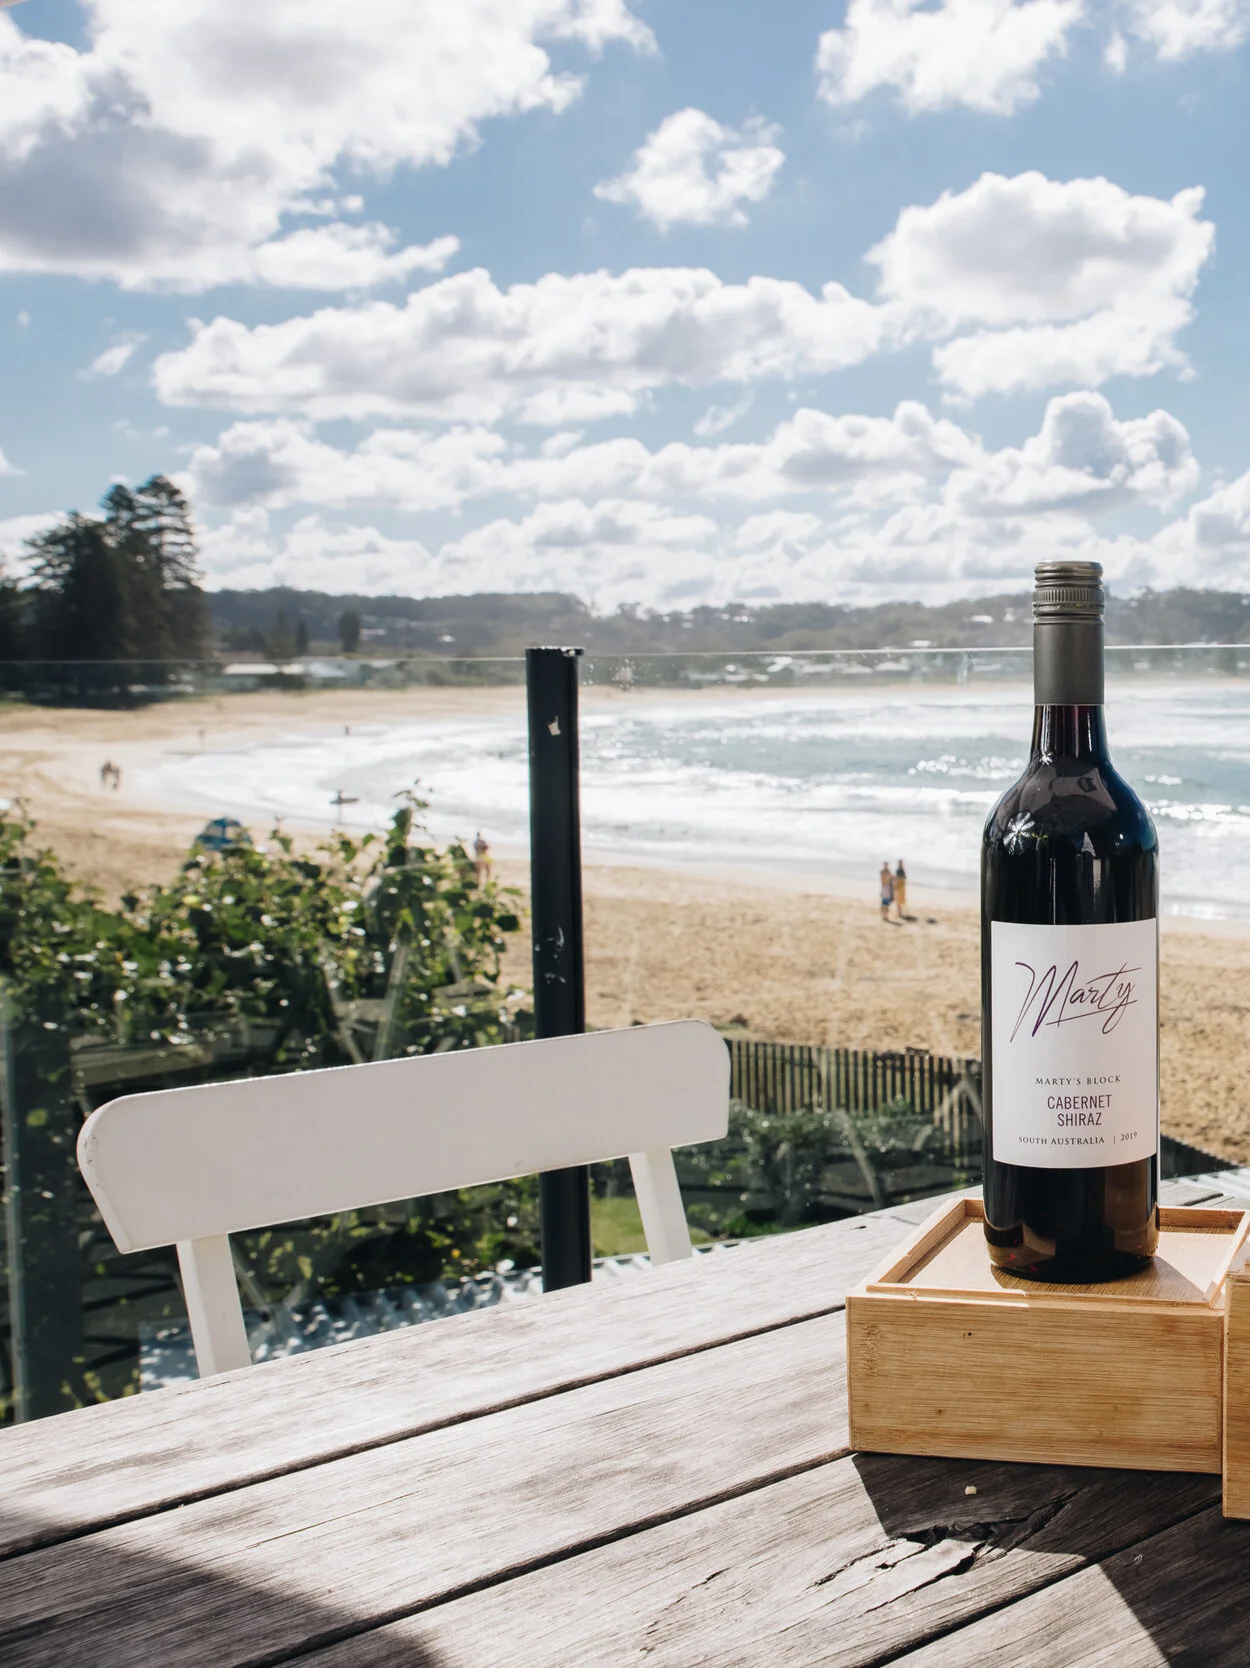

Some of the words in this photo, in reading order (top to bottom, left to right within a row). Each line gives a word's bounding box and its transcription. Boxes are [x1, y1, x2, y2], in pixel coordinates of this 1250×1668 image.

[1009, 960, 1143, 1043] Marty
[1035, 1077, 1082, 1086] MARTY'S
[1086, 1075, 1121, 1085] BLOCK
[1047, 1094, 1112, 1110] CABERNET
[1057, 1112, 1102, 1127] SHIRAZ
[1018, 1136, 1048, 1145] SOUTH
[1050, 1137, 1105, 1145] AUSTRALIA
[1120, 1131, 1138, 1142] 2019
